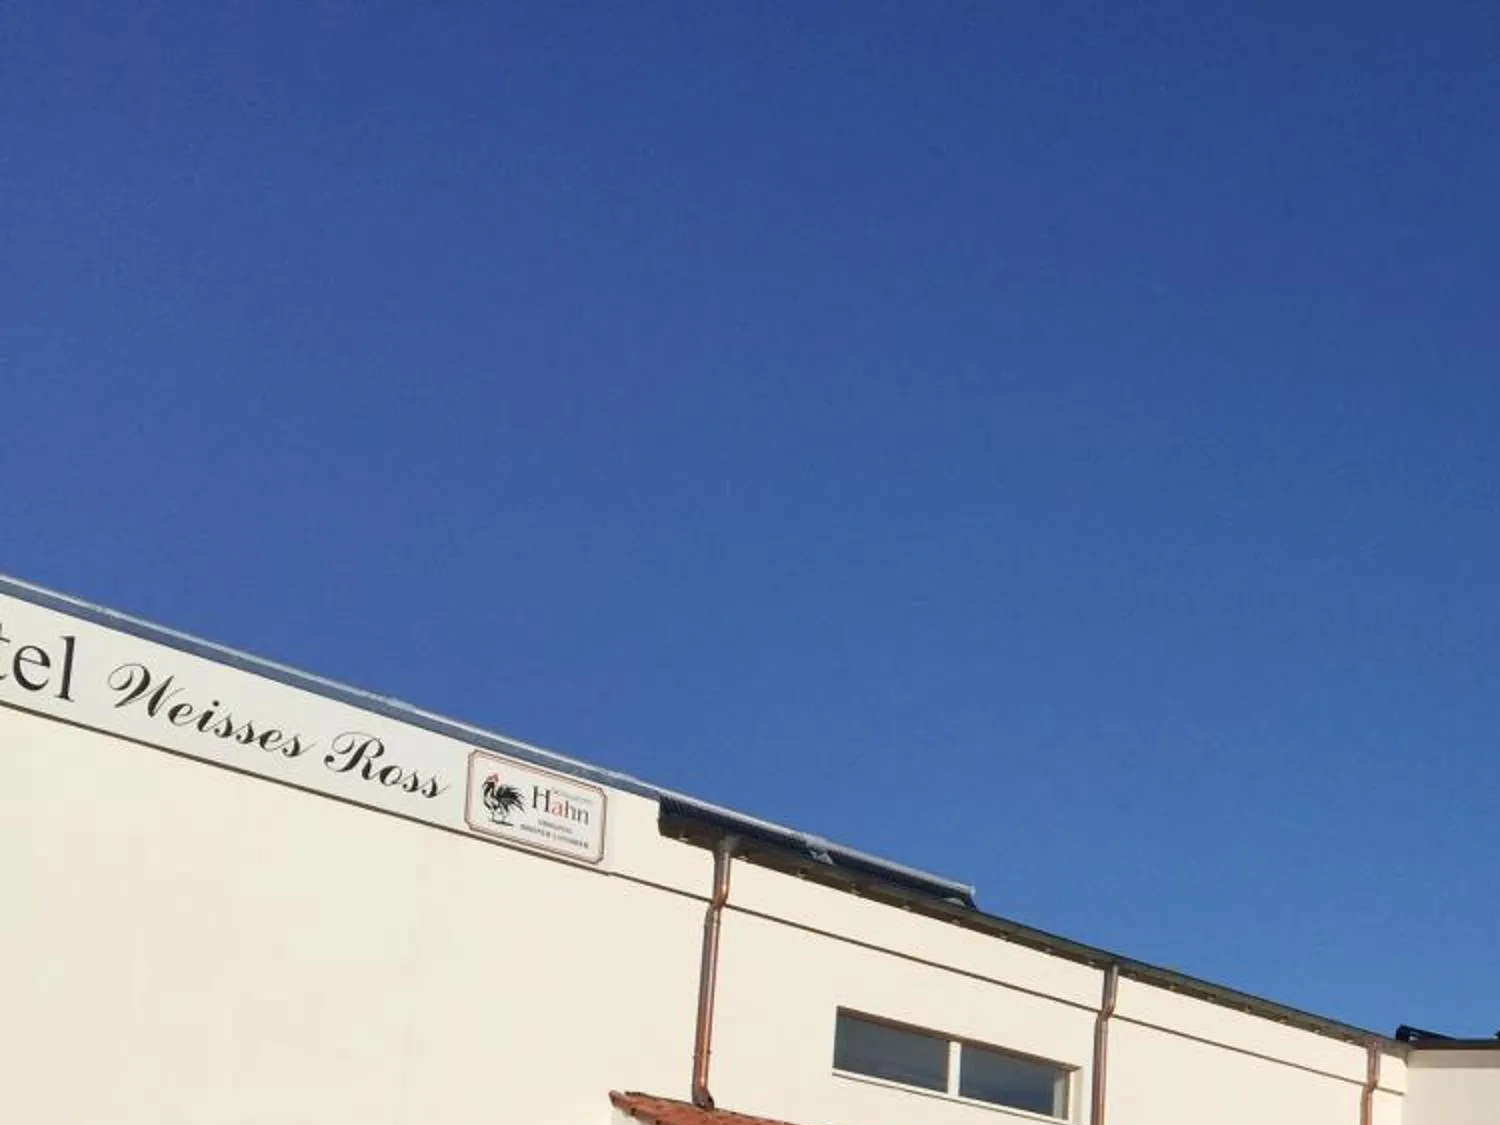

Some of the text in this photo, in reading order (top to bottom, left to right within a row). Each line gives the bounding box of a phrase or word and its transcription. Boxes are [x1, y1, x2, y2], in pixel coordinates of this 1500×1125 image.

[107, 663, 317, 758] Weisses
[323, 731, 449, 799] Ross
[532, 785, 589, 825] Hahn
